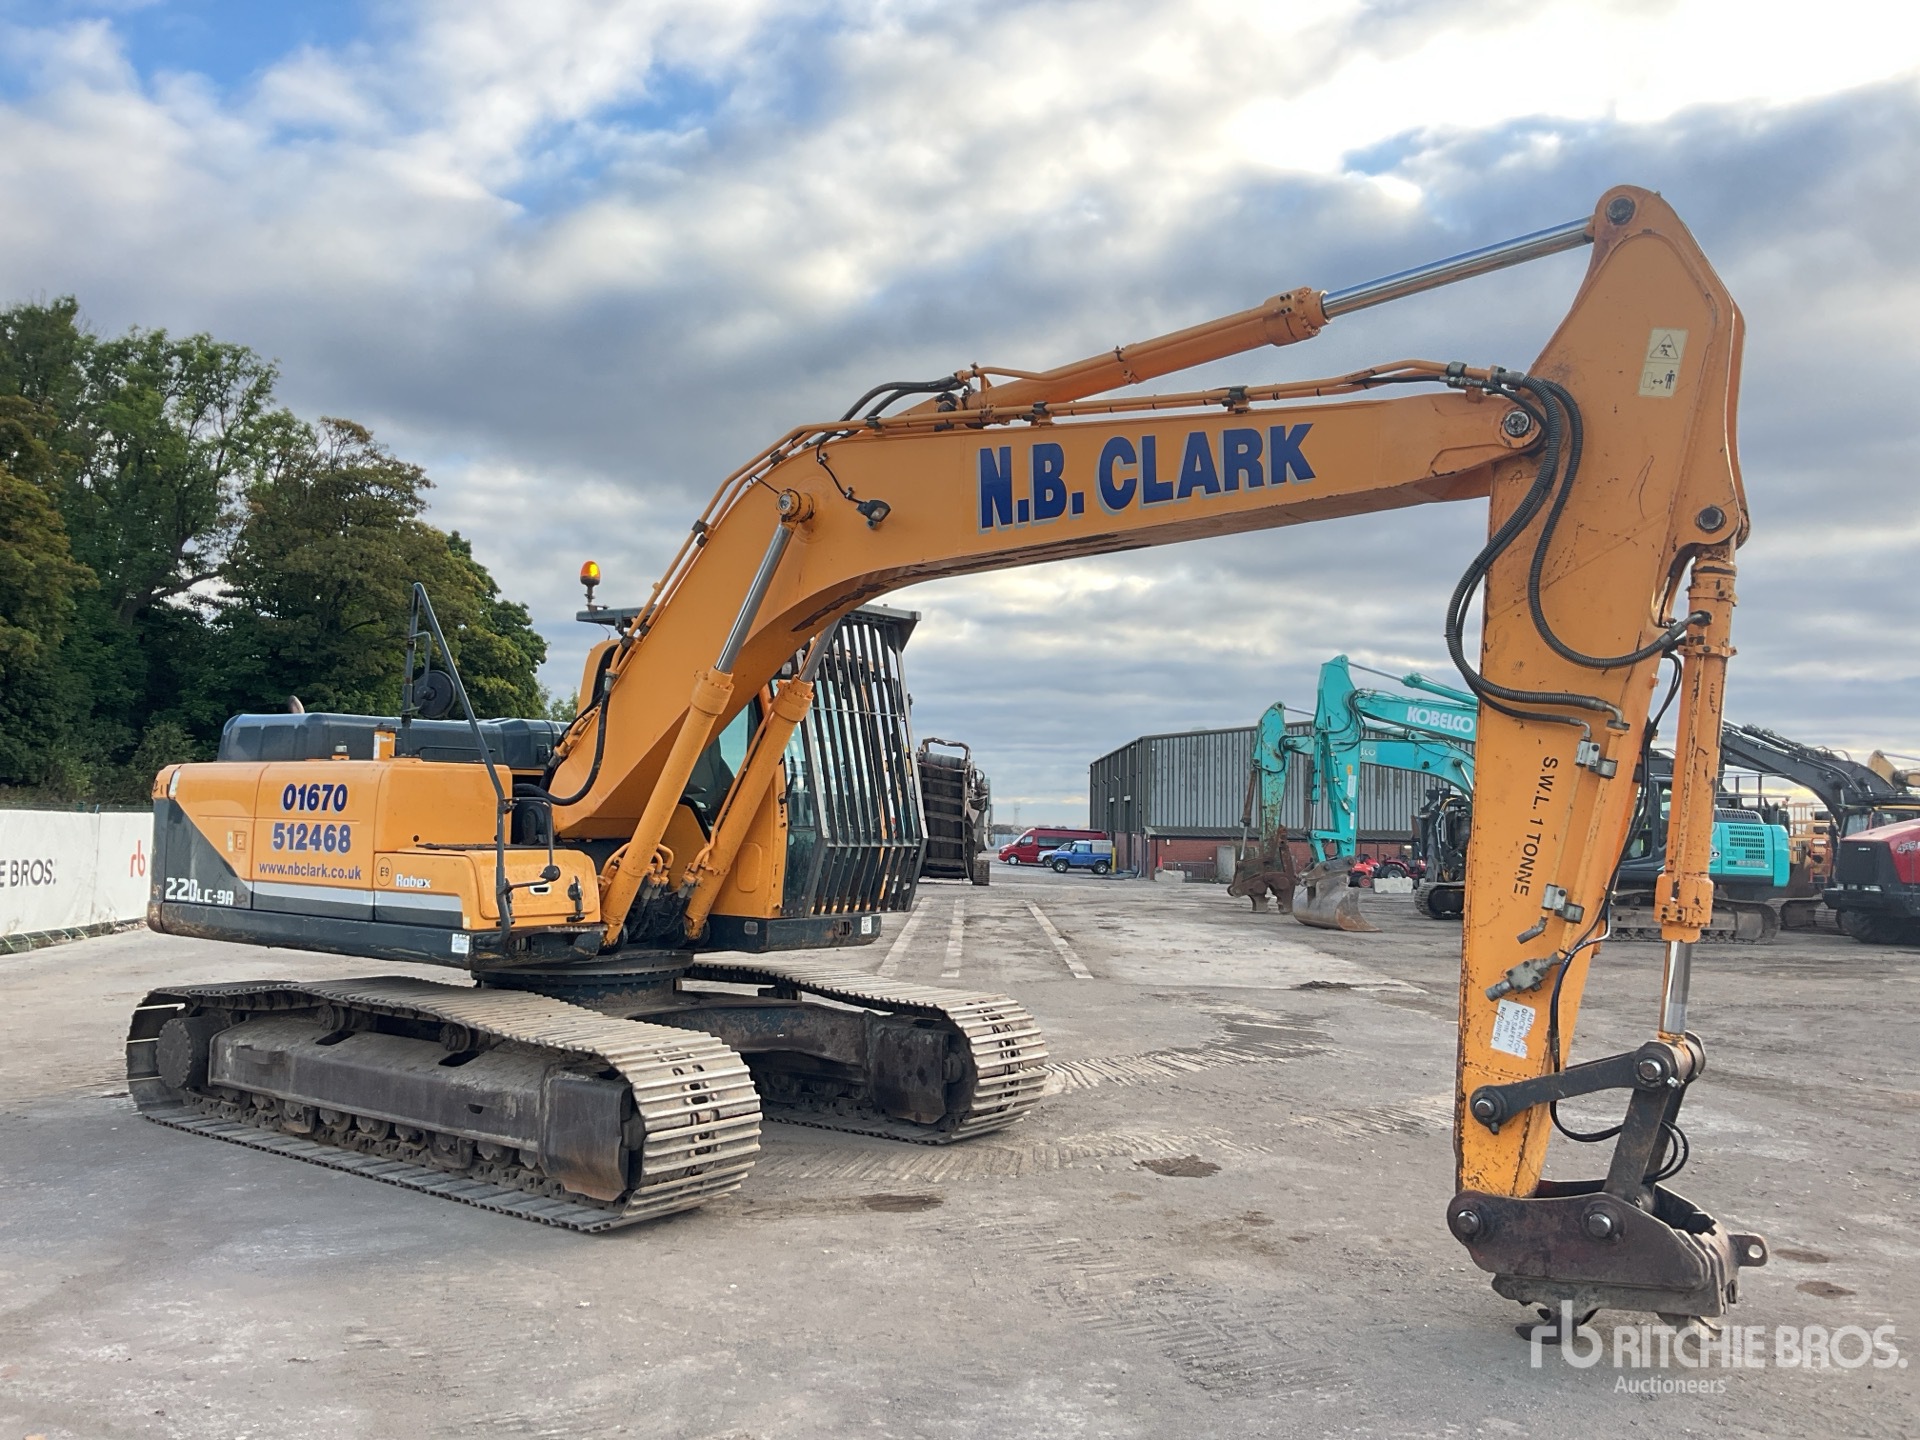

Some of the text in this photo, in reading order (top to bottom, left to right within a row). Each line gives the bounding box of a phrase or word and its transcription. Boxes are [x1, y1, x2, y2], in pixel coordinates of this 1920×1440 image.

[979, 423, 1316, 531] N.B. CLARK
[1406, 706, 1474, 733] KOBELCO
[282, 783, 348, 813] 01670
[272, 822, 351, 854] 512468
[1514, 756, 1559, 896] S.W.L. 1 TONNE
[9, 858, 57, 888] BROS.
[129, 840, 146, 878] rb
[259, 862, 362, 881] www.nbclark.co.uk
[380, 867, 390, 878] E9
[395, 873, 432, 889] Robex
[1493, 1006, 1507, 1042] REQUIRED
[1503, 1020, 1511, 1033] PIN
[1507, 1009, 1521, 1048] NO SAFETY
[1518, 1008, 1528, 1031] QUICK
